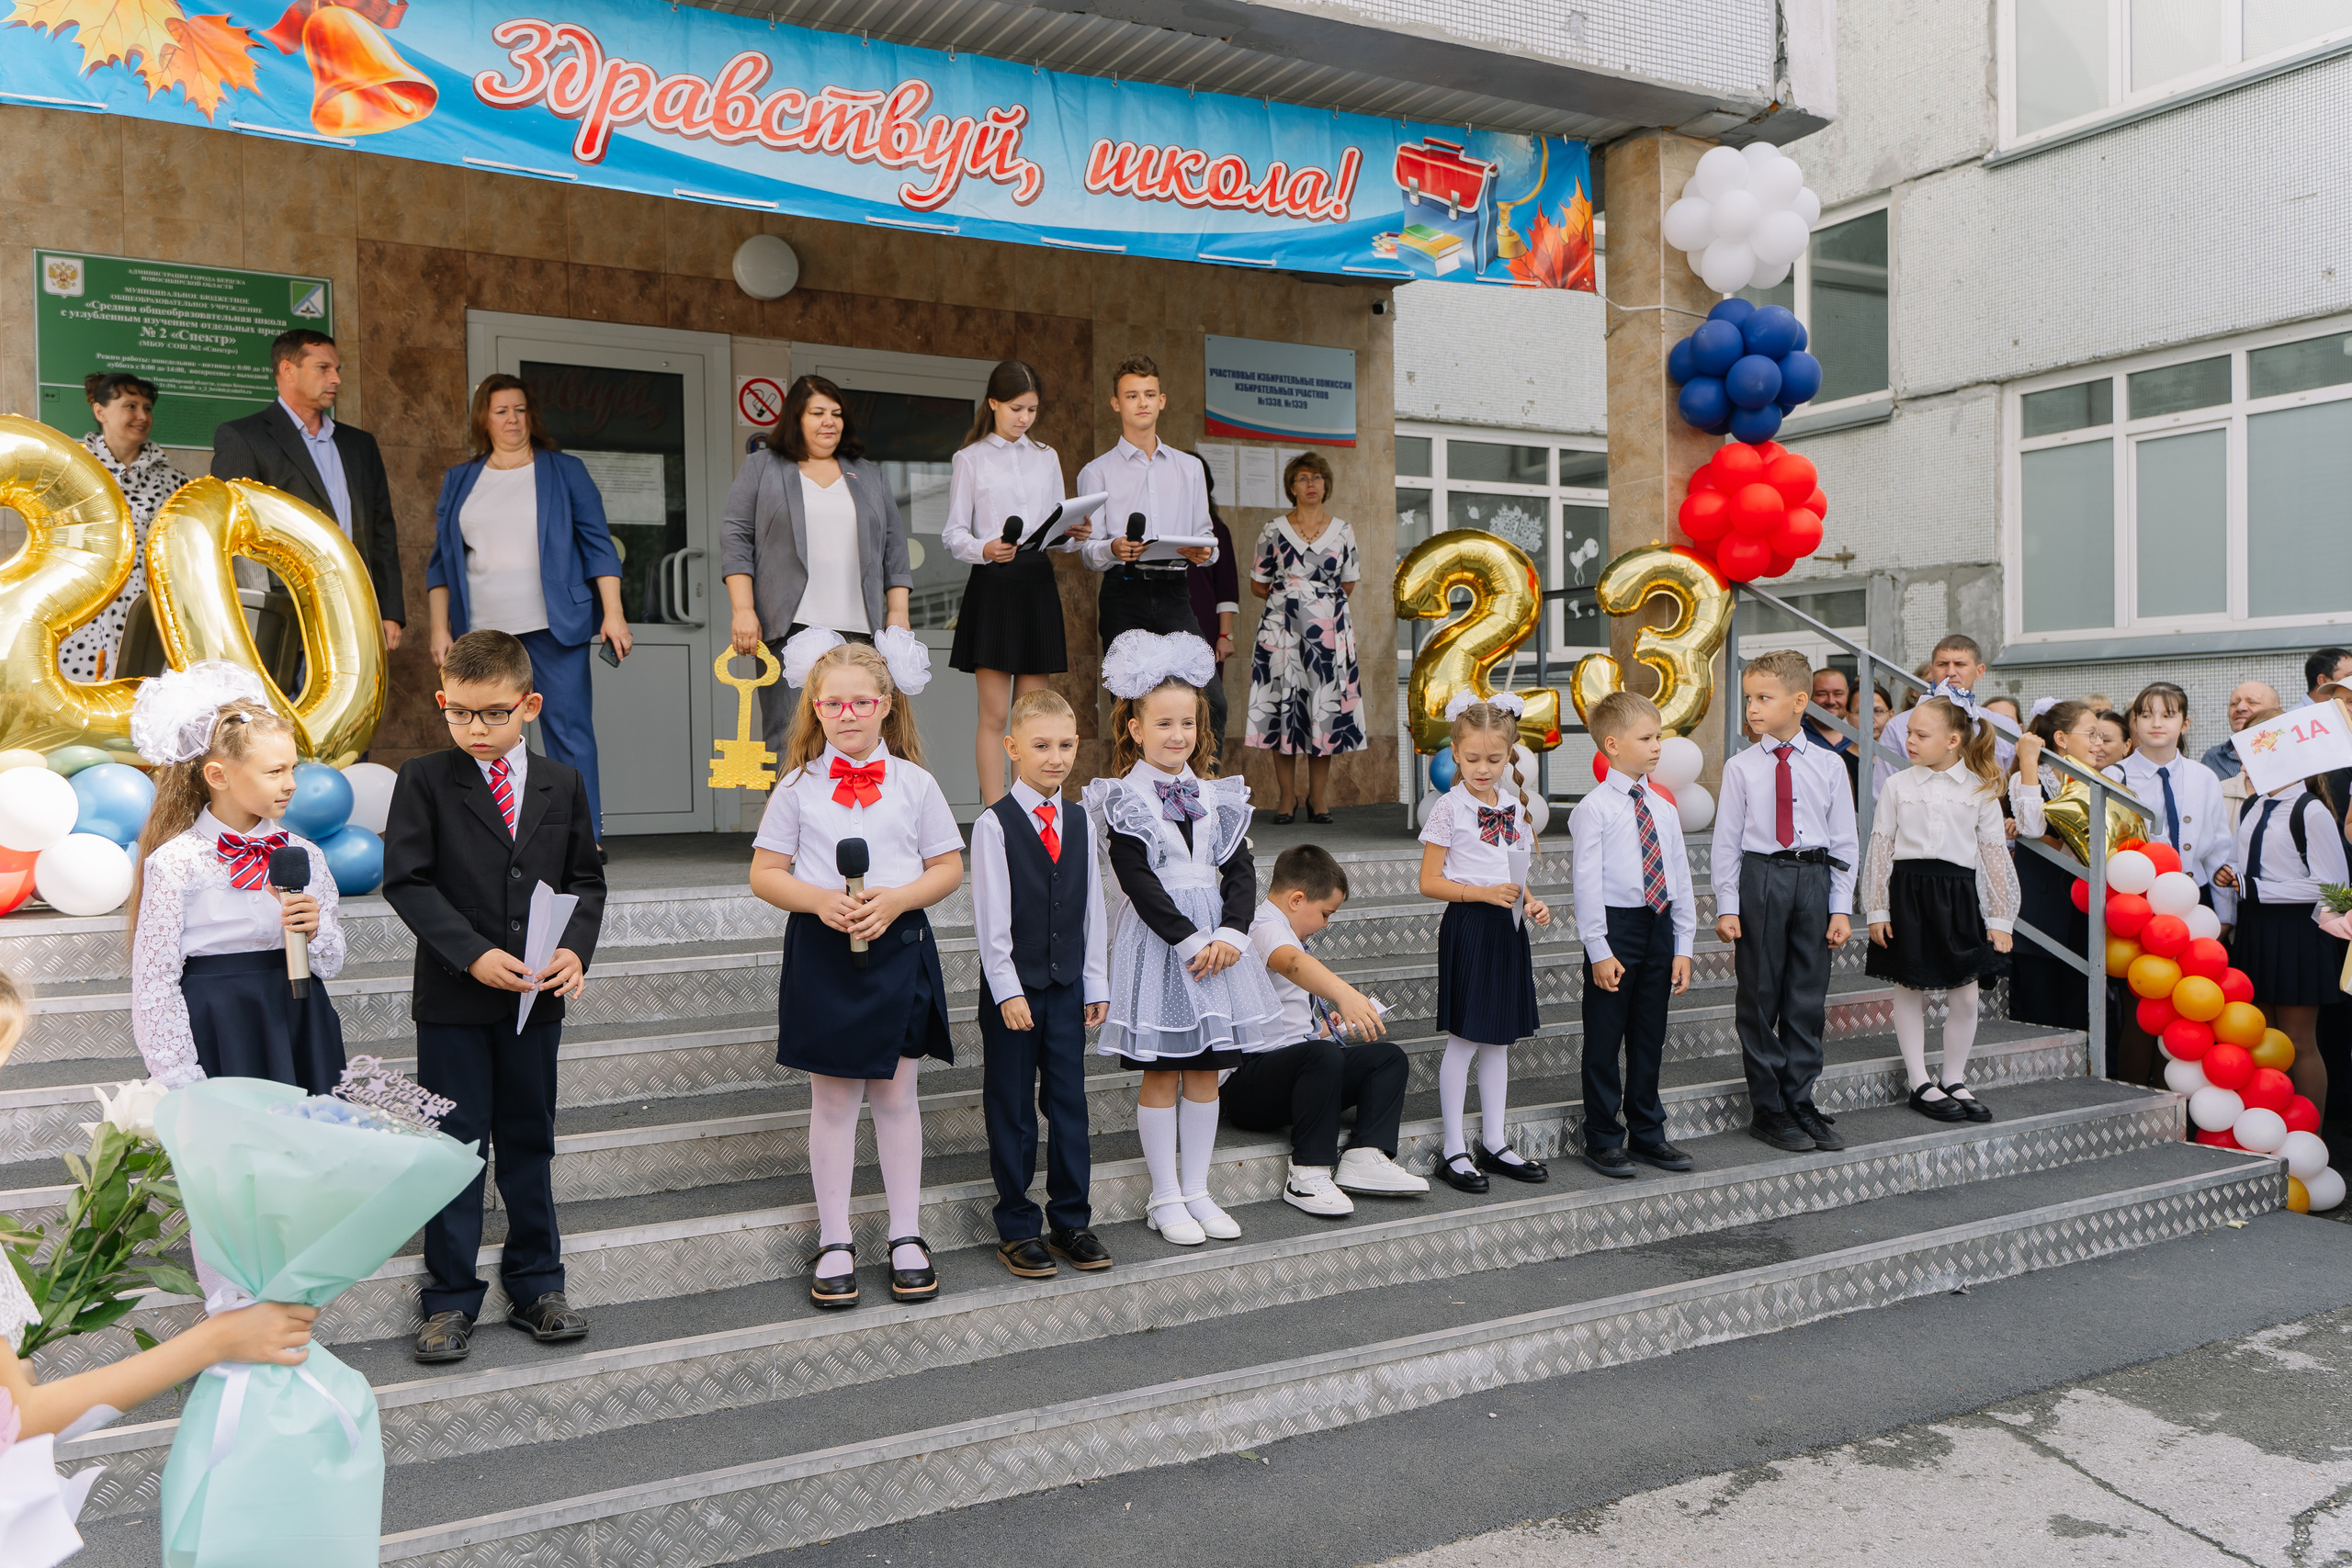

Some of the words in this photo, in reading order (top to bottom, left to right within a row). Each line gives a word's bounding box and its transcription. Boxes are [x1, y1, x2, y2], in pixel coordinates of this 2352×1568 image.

[472, 17, 1045, 213] Здравствуй,
[1084, 136, 1365, 225] школа!
[128, 268, 188, 279] АДМИНИСТРАЦИЯ
[190, 275, 216, 283] ГОРОДА
[217, 277, 246, 286] БЕРДСКА
[141, 276, 201, 287] НОВОСИБИРСКОЙ
[202, 281, 233, 290] ОБЛАСТИ
[110, 294, 209, 309] ОБЩЕОБРАЗОВАТЕЛЬНОЕ
[210, 303, 263, 314] УЧРЕЖДЕНИЕ
[124, 287, 198, 299] МУНИЦИПАЛЬНОЕ
[199, 295, 250, 305] БЮДЖЕТНОЕ
[60, 309, 67, 317] с
[69, 310, 141, 323] углубленным
[143, 315, 198, 329] изучением
[199, 321, 255, 333] отдельных
[85, 299, 137, 312] «Средняя
[140, 305, 252, 323] общеобразовательная
[254, 317, 287, 327] школа
[140, 326, 156, 338] №
[159, 327, 167, 339] 2
[170, 329, 236, 346] «Спектр»
[139, 340, 165, 348] (МБОУ
[202, 345, 239, 355] «Спектр»)
[122, 355, 150, 363] работы:
[152, 358, 196, 367] понедельник
[107, 362, 134, 370] суббота
[189, 368, 232, 377] воскресенье
[236, 372, 269, 380] выходной
[1209, 367, 1256, 380] УЧАСТКОВЫЕ
[1257, 372, 1315, 386] ИЗБИРАТЕЛЬНЫЕ
[1316, 378, 1352, 389] КОМИССИИ
[1235, 382, 1294, 396] ИЗБИРАТЕЛЬНЫХ
[1295, 388, 1329, 400] УЧАСТКОВ
[1283, 399, 1307, 410] №1339
